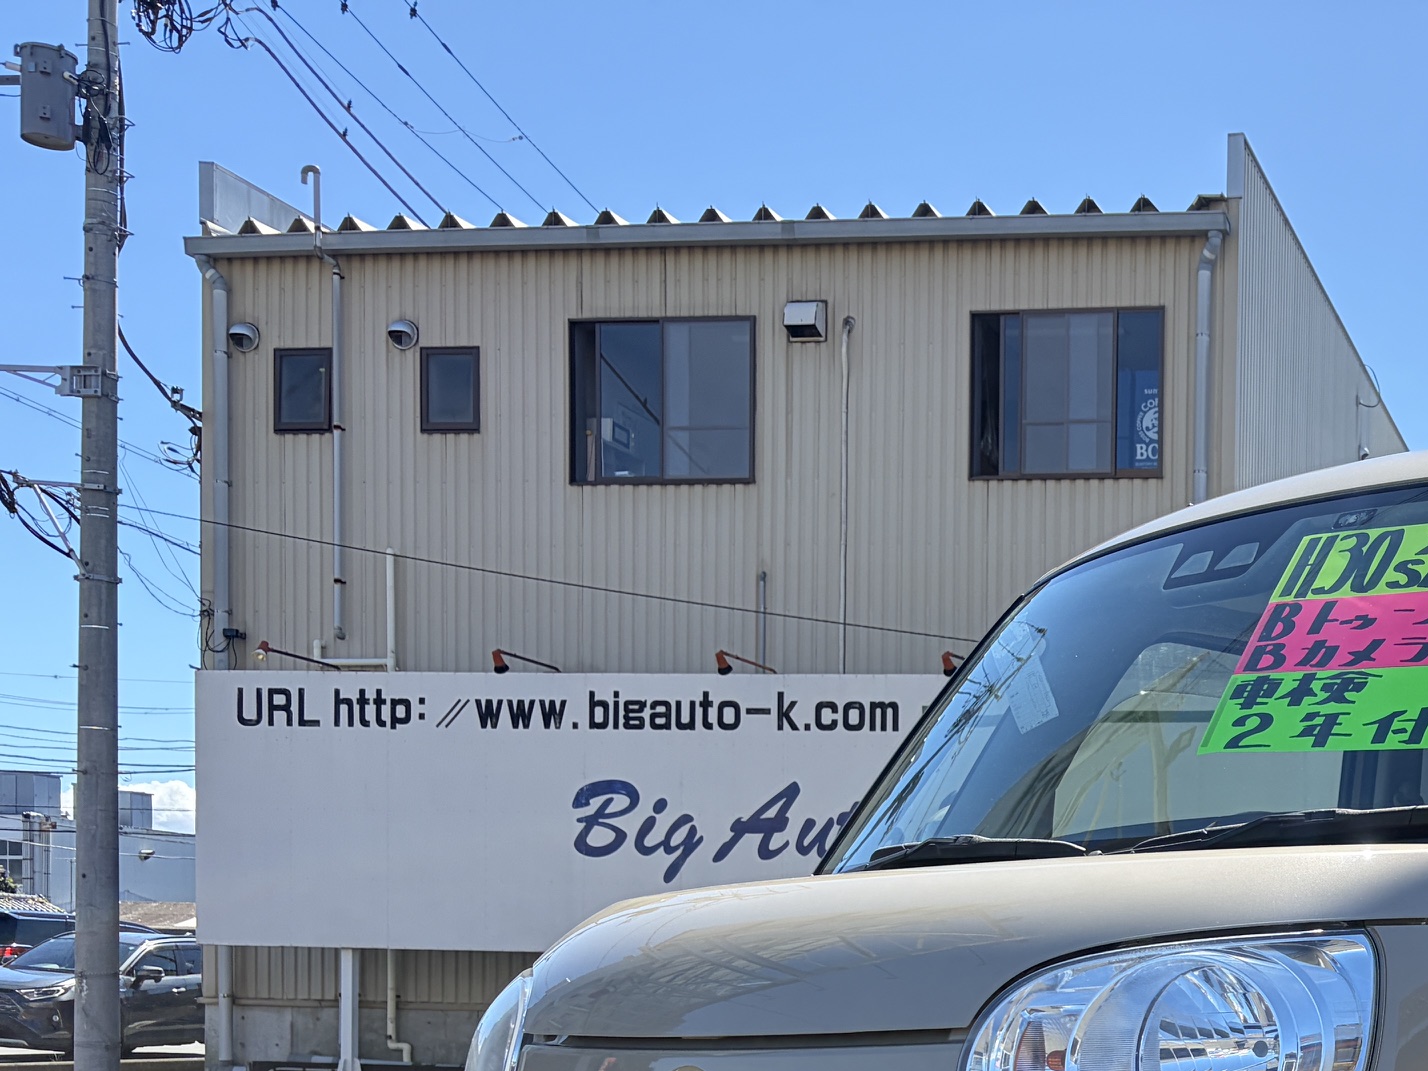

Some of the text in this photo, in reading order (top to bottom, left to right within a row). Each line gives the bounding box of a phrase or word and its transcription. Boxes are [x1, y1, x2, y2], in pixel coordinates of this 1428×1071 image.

[1279, 528, 1405, 599] H30
[236, 687, 321, 728] URL
[1229, 671, 1384, 710] 車検
[571, 779, 704, 884] Big
